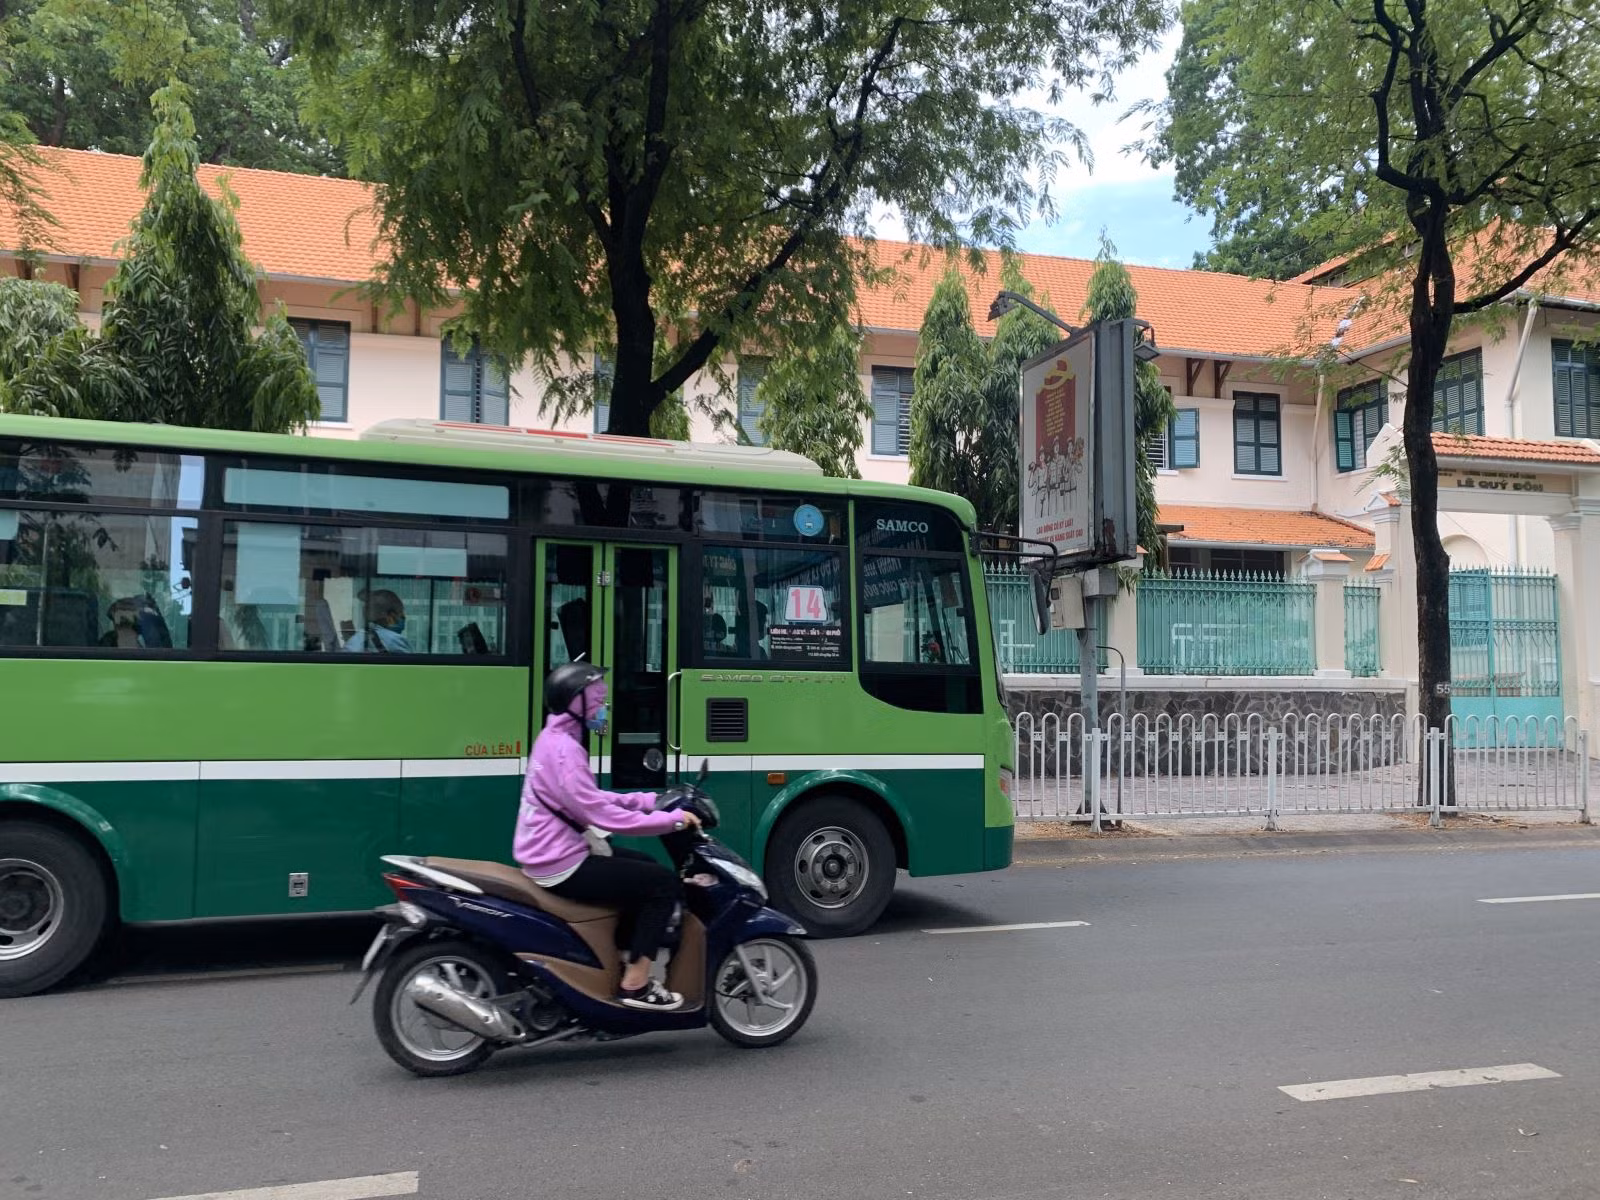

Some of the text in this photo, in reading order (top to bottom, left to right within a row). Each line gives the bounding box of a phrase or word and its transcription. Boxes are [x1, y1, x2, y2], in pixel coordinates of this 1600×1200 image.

[1457, 477, 1475, 488] LÊ
[1478, 479, 1508, 490] QUÝ
[876, 518, 929, 533] SAMCO
[791, 588, 821, 619] 14
[700, 673, 763, 682] SAMCO
[1436, 683, 1451, 694] 55
[491, 742, 513, 755] LÊN
